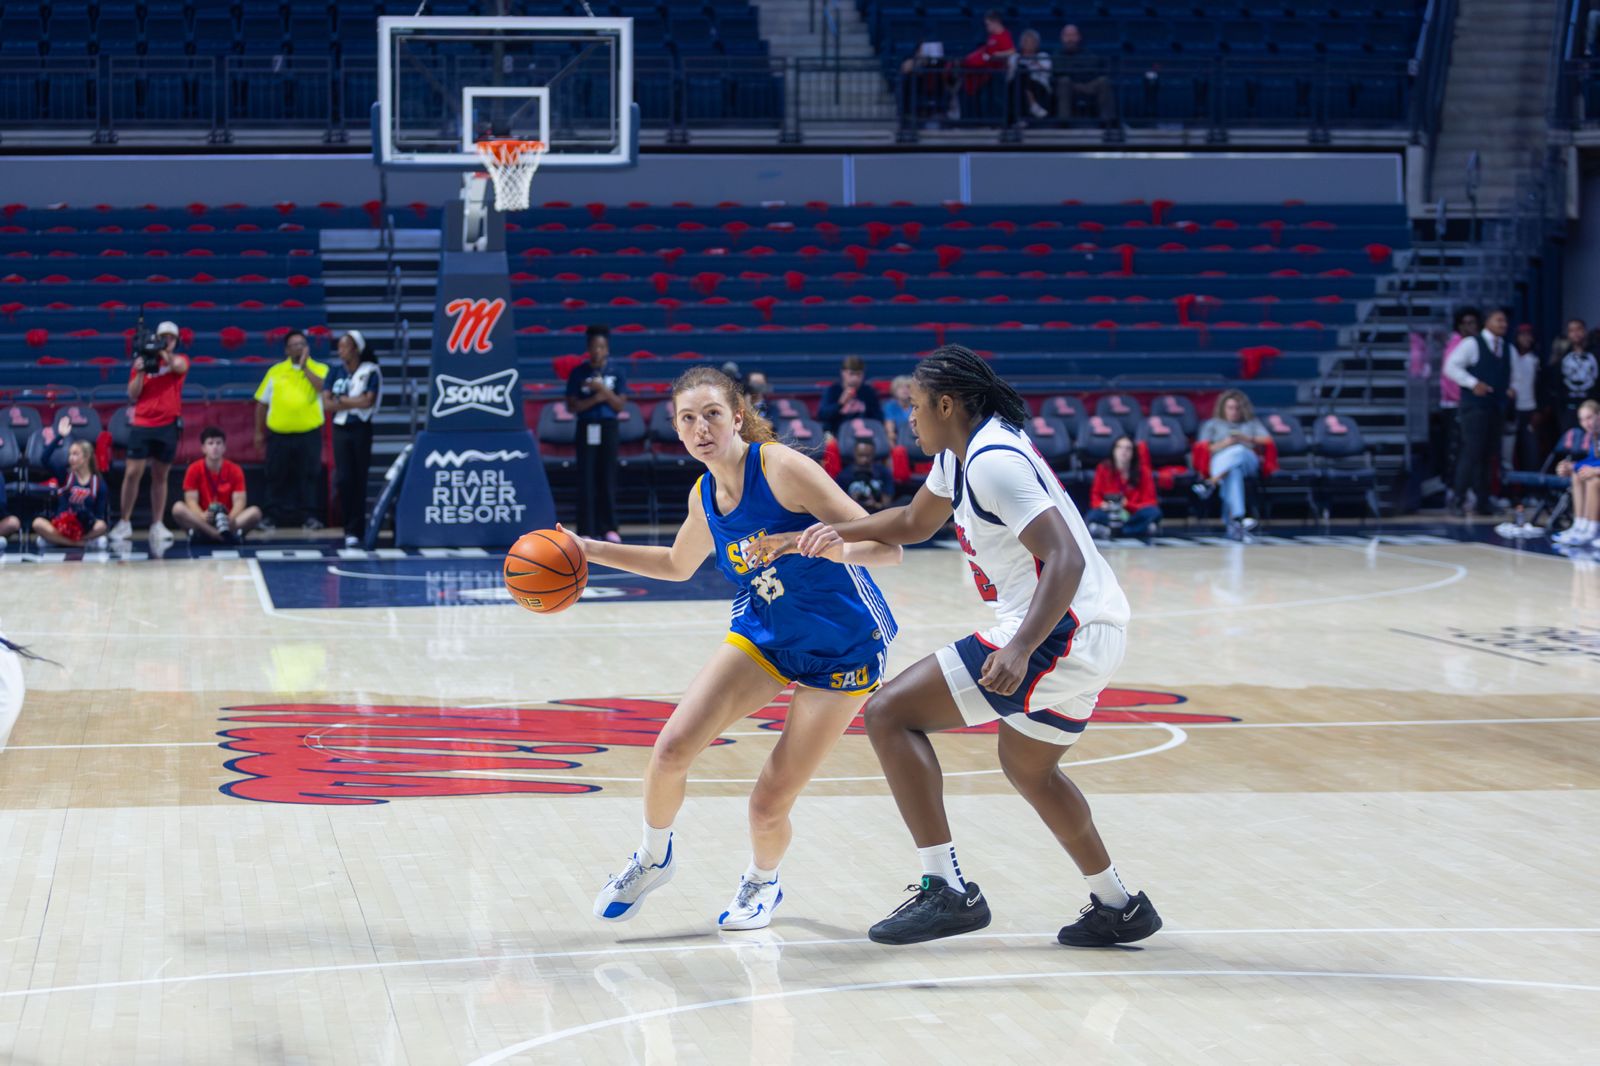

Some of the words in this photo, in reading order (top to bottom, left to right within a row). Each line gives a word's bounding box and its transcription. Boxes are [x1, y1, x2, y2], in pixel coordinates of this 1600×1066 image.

[445, 298, 506, 353] M
[443, 384, 506, 404] SONIC
[434, 469, 513, 488] PEARL
[431, 486, 518, 507] RIVER
[424, 505, 527, 524] RESORT
[750, 566, 785, 606] 25
[968, 560, 998, 602] 2
[830, 665, 869, 688] SAU
